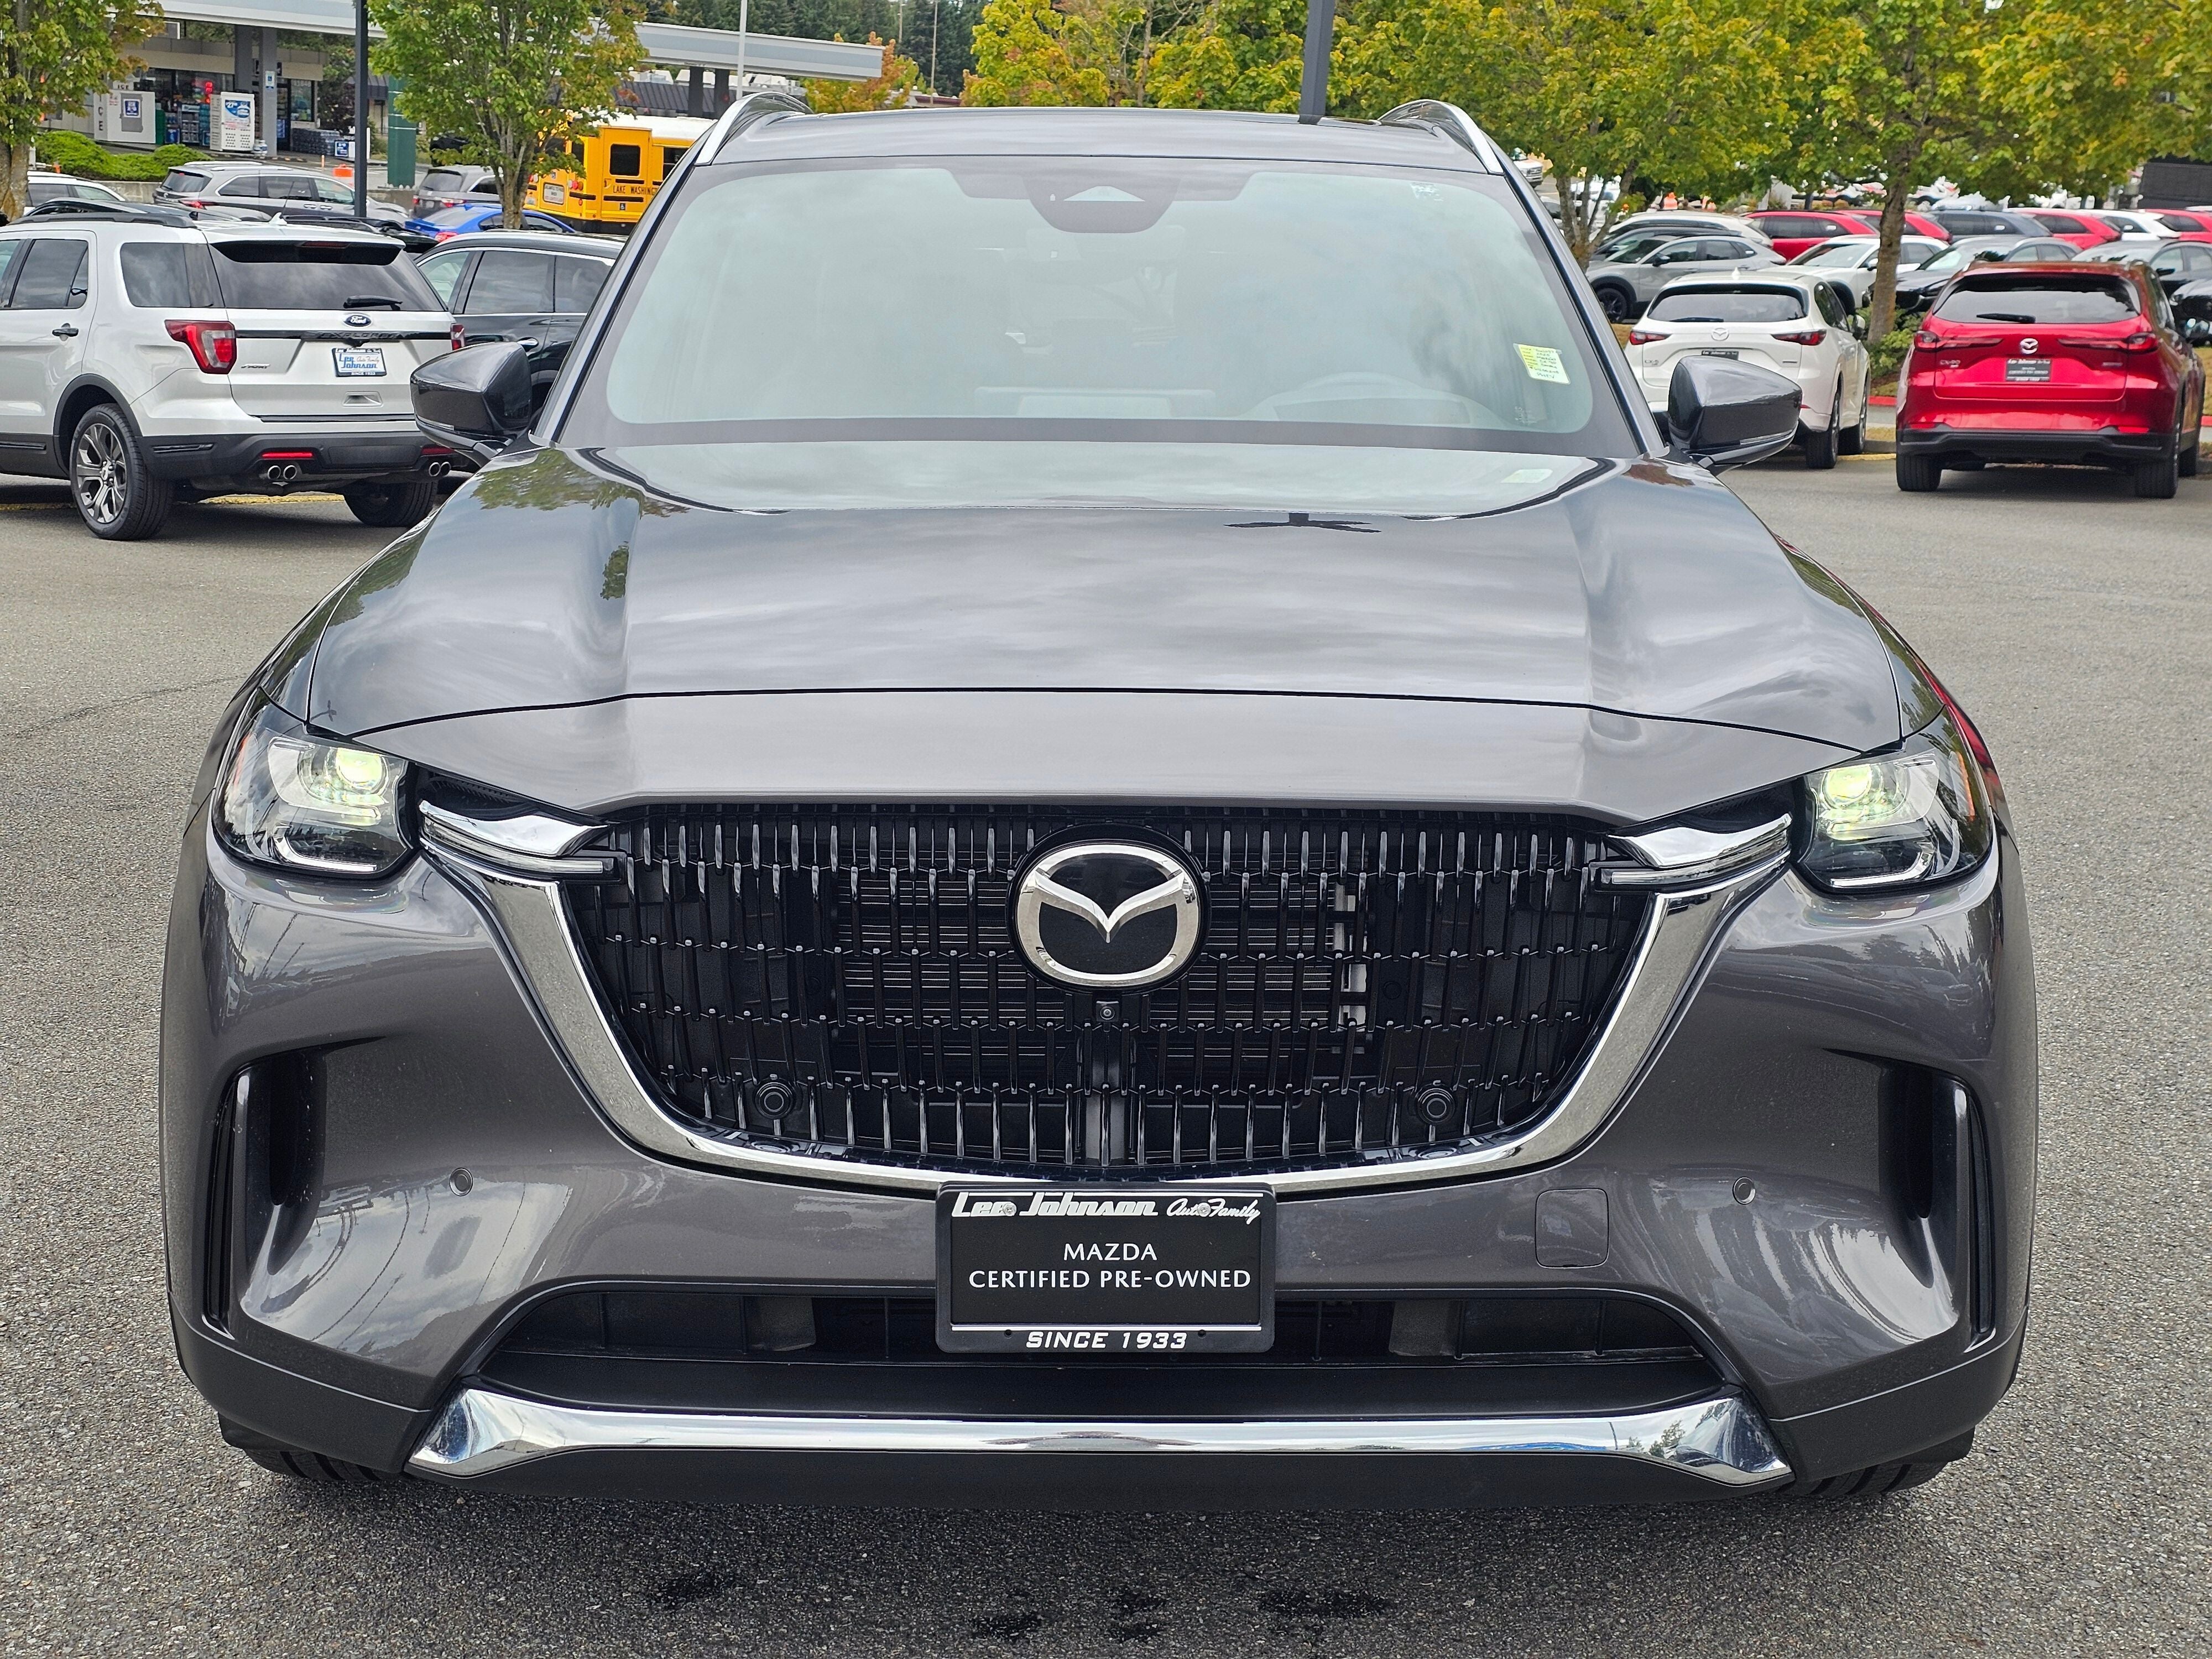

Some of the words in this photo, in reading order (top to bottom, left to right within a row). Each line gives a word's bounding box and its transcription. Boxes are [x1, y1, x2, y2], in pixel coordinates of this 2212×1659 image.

[613, 185, 625, 194] LAKE
[951, 1192, 1016, 1217] Lee
[1019, 1192, 1159, 1216] Johnson
[1166, 1198, 1211, 1217] Aut
[1208, 1198, 1261, 1225] Family
[1063, 1243, 1157, 1261] MAZDA
[969, 1270, 1090, 1288] CERTIFIED
[1100, 1270, 1251, 1288] PRE-OWNED
[1026, 1332, 1109, 1348] SINCE
[1122, 1332, 1187, 1349] 1933
